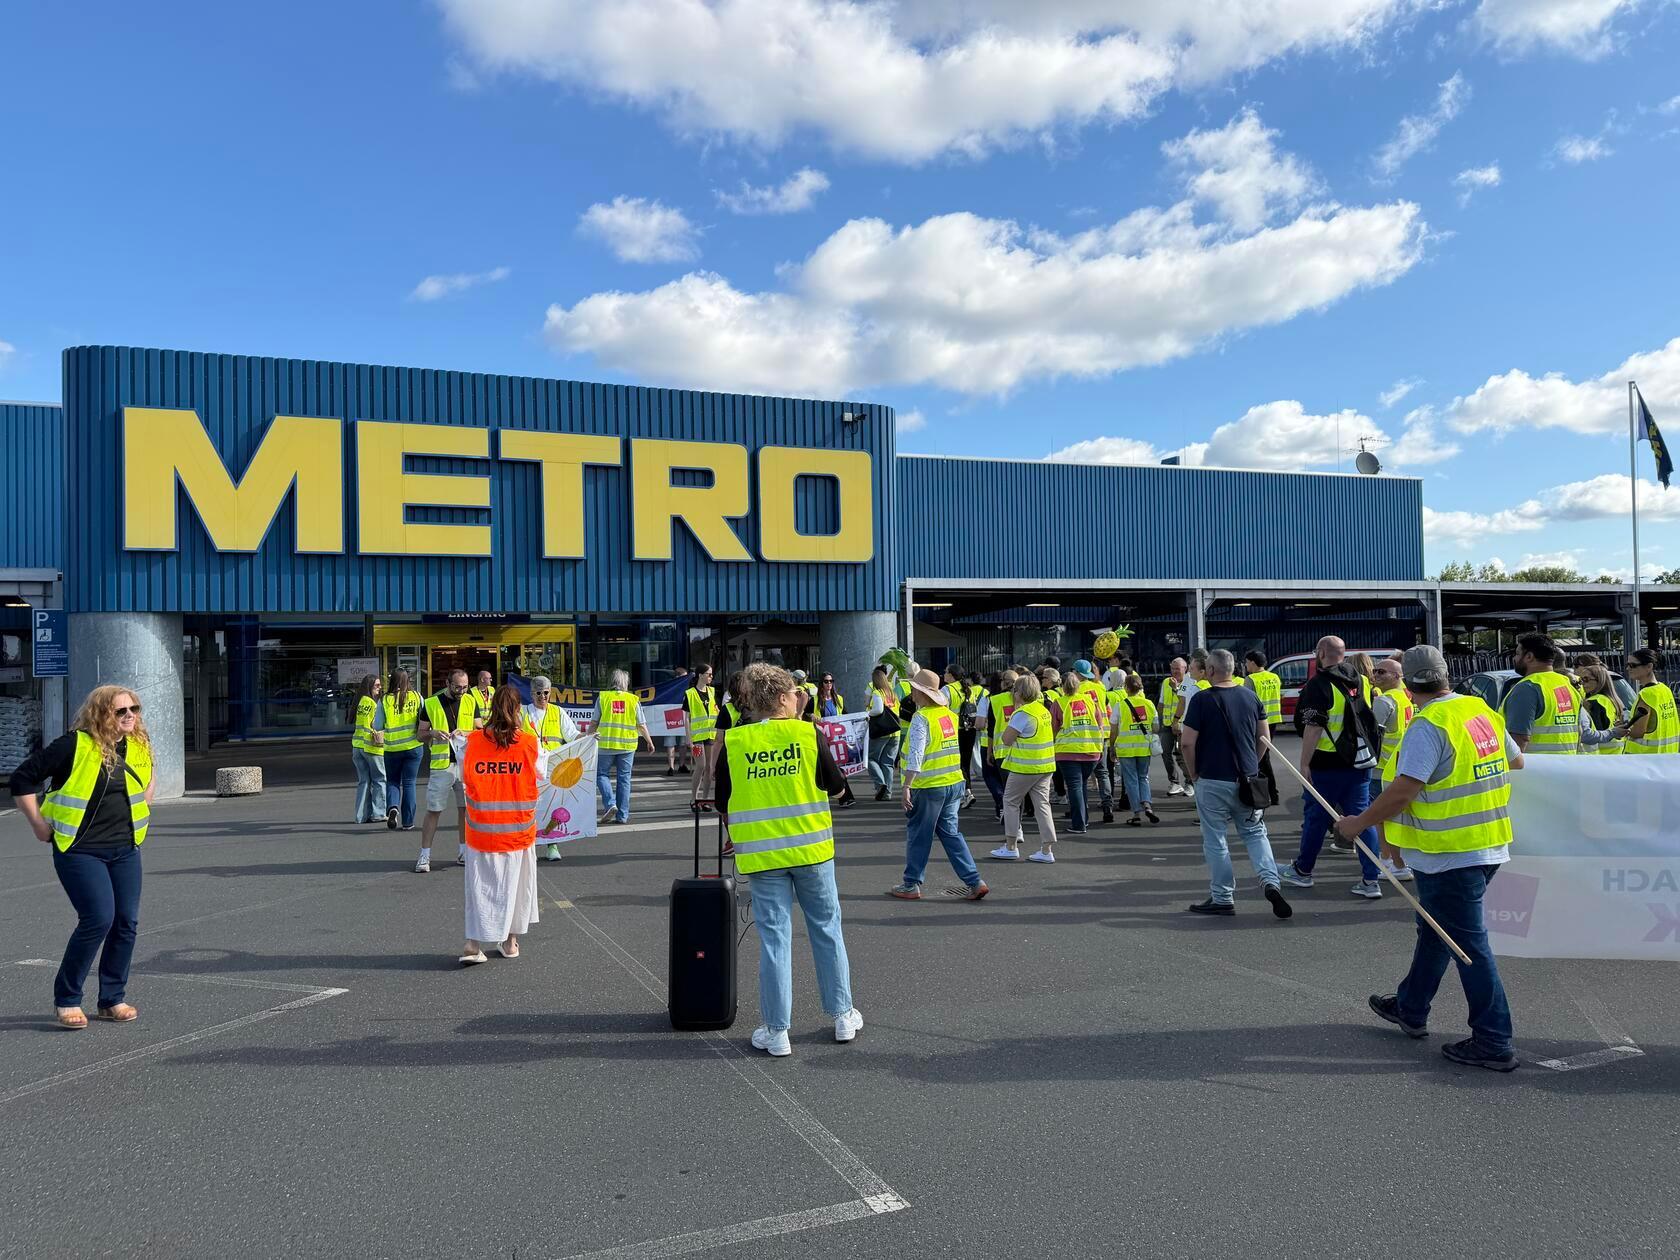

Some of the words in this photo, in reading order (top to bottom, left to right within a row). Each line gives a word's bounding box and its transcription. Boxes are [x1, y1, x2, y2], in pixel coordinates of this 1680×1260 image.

[123, 406, 875, 563] METRO
[36, 612, 49, 628] P
[550, 687, 656, 705] MEO
[1475, 736, 1498, 750] ver.di
[744, 743, 801, 765] ver.di
[475, 761, 523, 774] CREW
[746, 760, 801, 780] Handel
